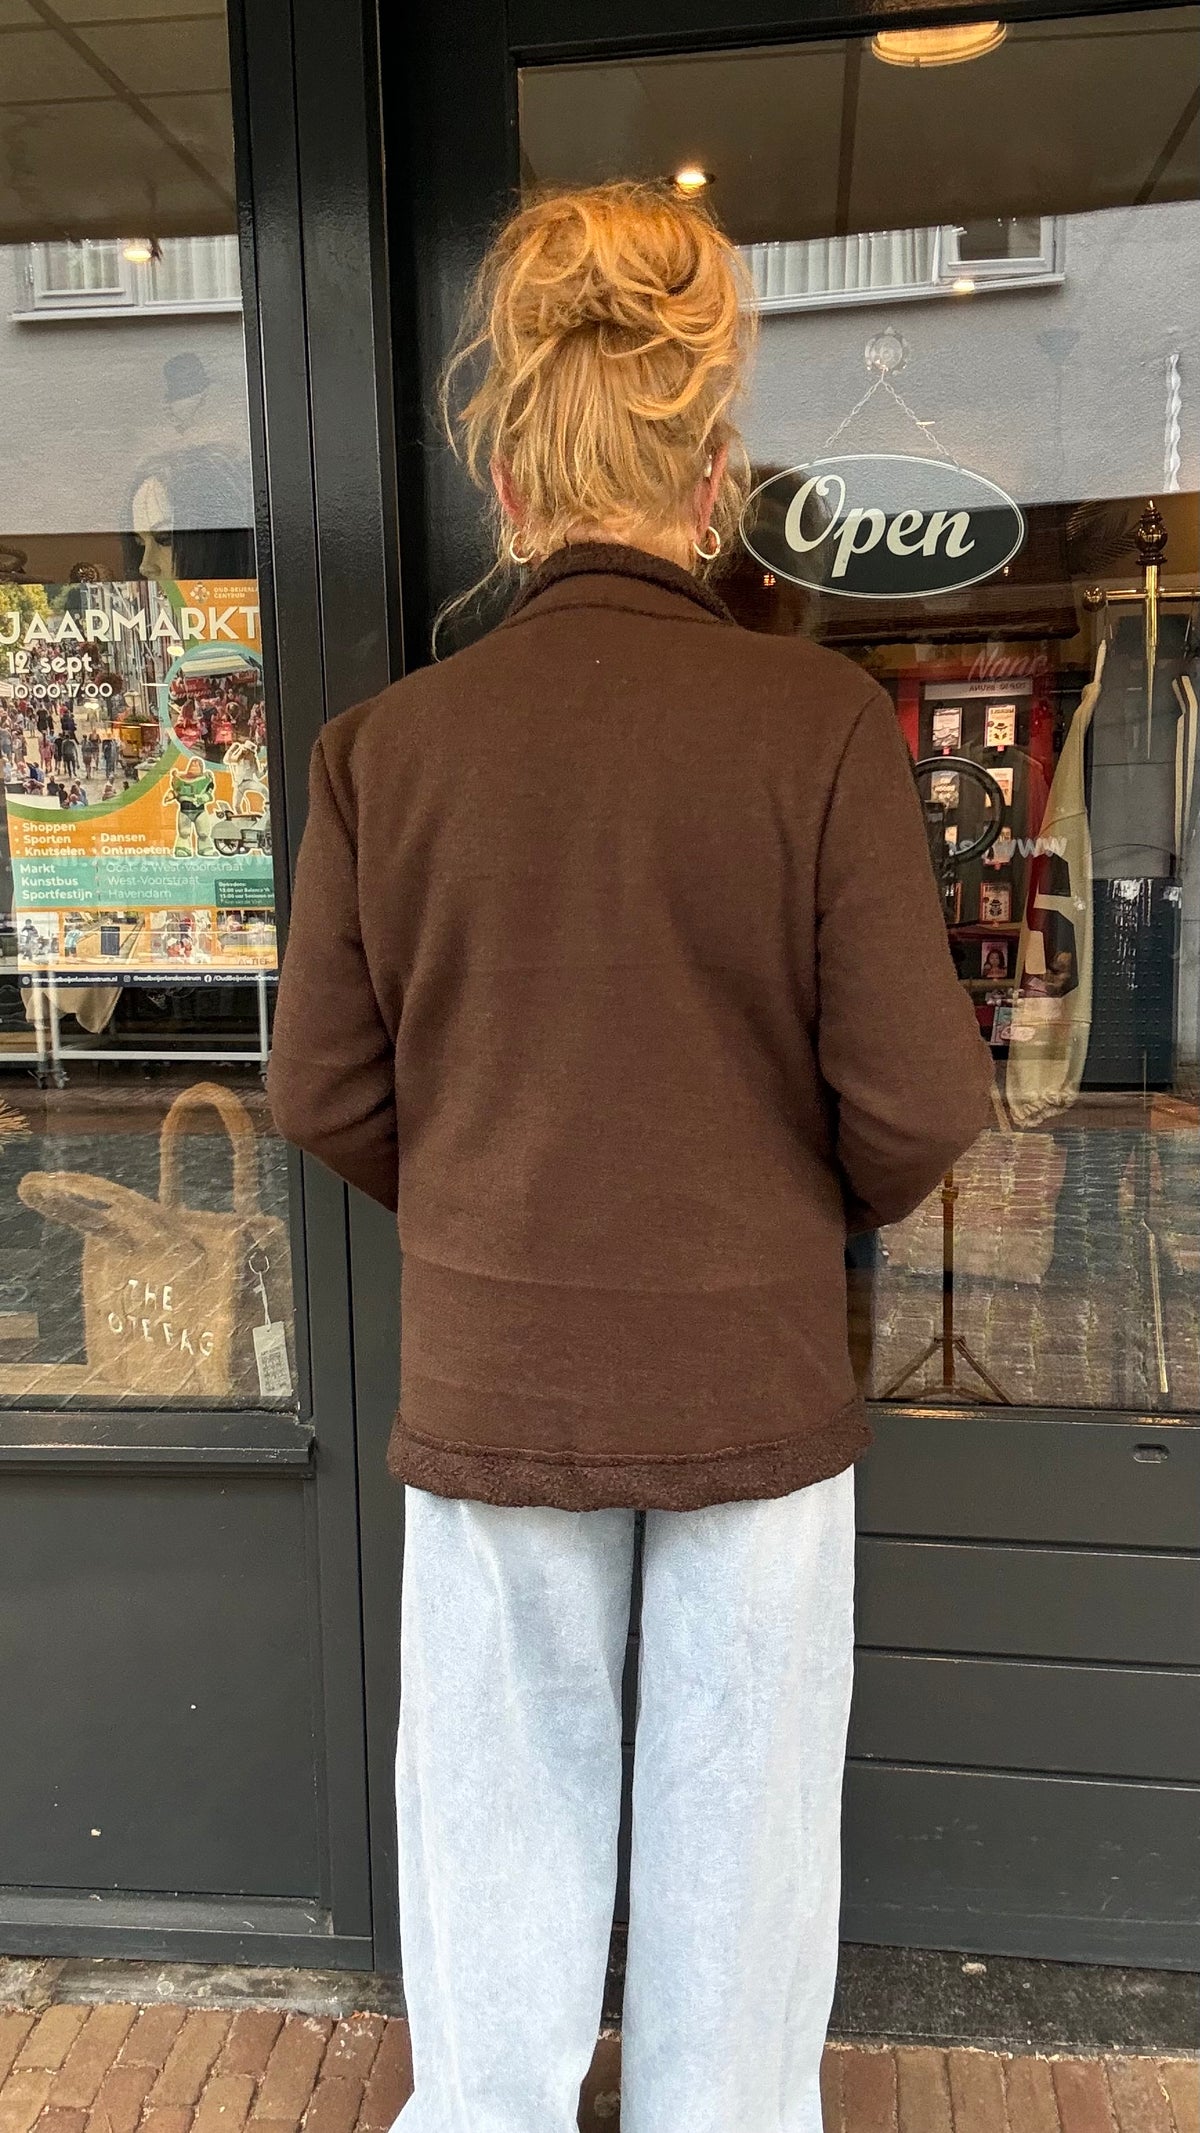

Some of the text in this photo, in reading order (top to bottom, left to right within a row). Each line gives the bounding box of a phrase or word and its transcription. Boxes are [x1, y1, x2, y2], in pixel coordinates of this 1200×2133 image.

[784, 474, 975, 578] Open
[0, 607, 259, 644] JAARMARKT
[7, 651, 93, 682] 12 sept
[22, 821, 76, 834] Shoppen
[23, 833, 72, 845] Sporten
[100, 832, 146, 843] Dansen
[24, 845, 86, 857] Knutselen
[101, 844, 171, 856] Ontmoeten
[20, 863, 56, 874] Markt
[21, 875, 79, 888] Kunstbus
[108, 874, 200, 887] West-Voorstraat
[22, 887, 93, 901] Sportfestijn
[109, 888, 172, 900] Havendam
